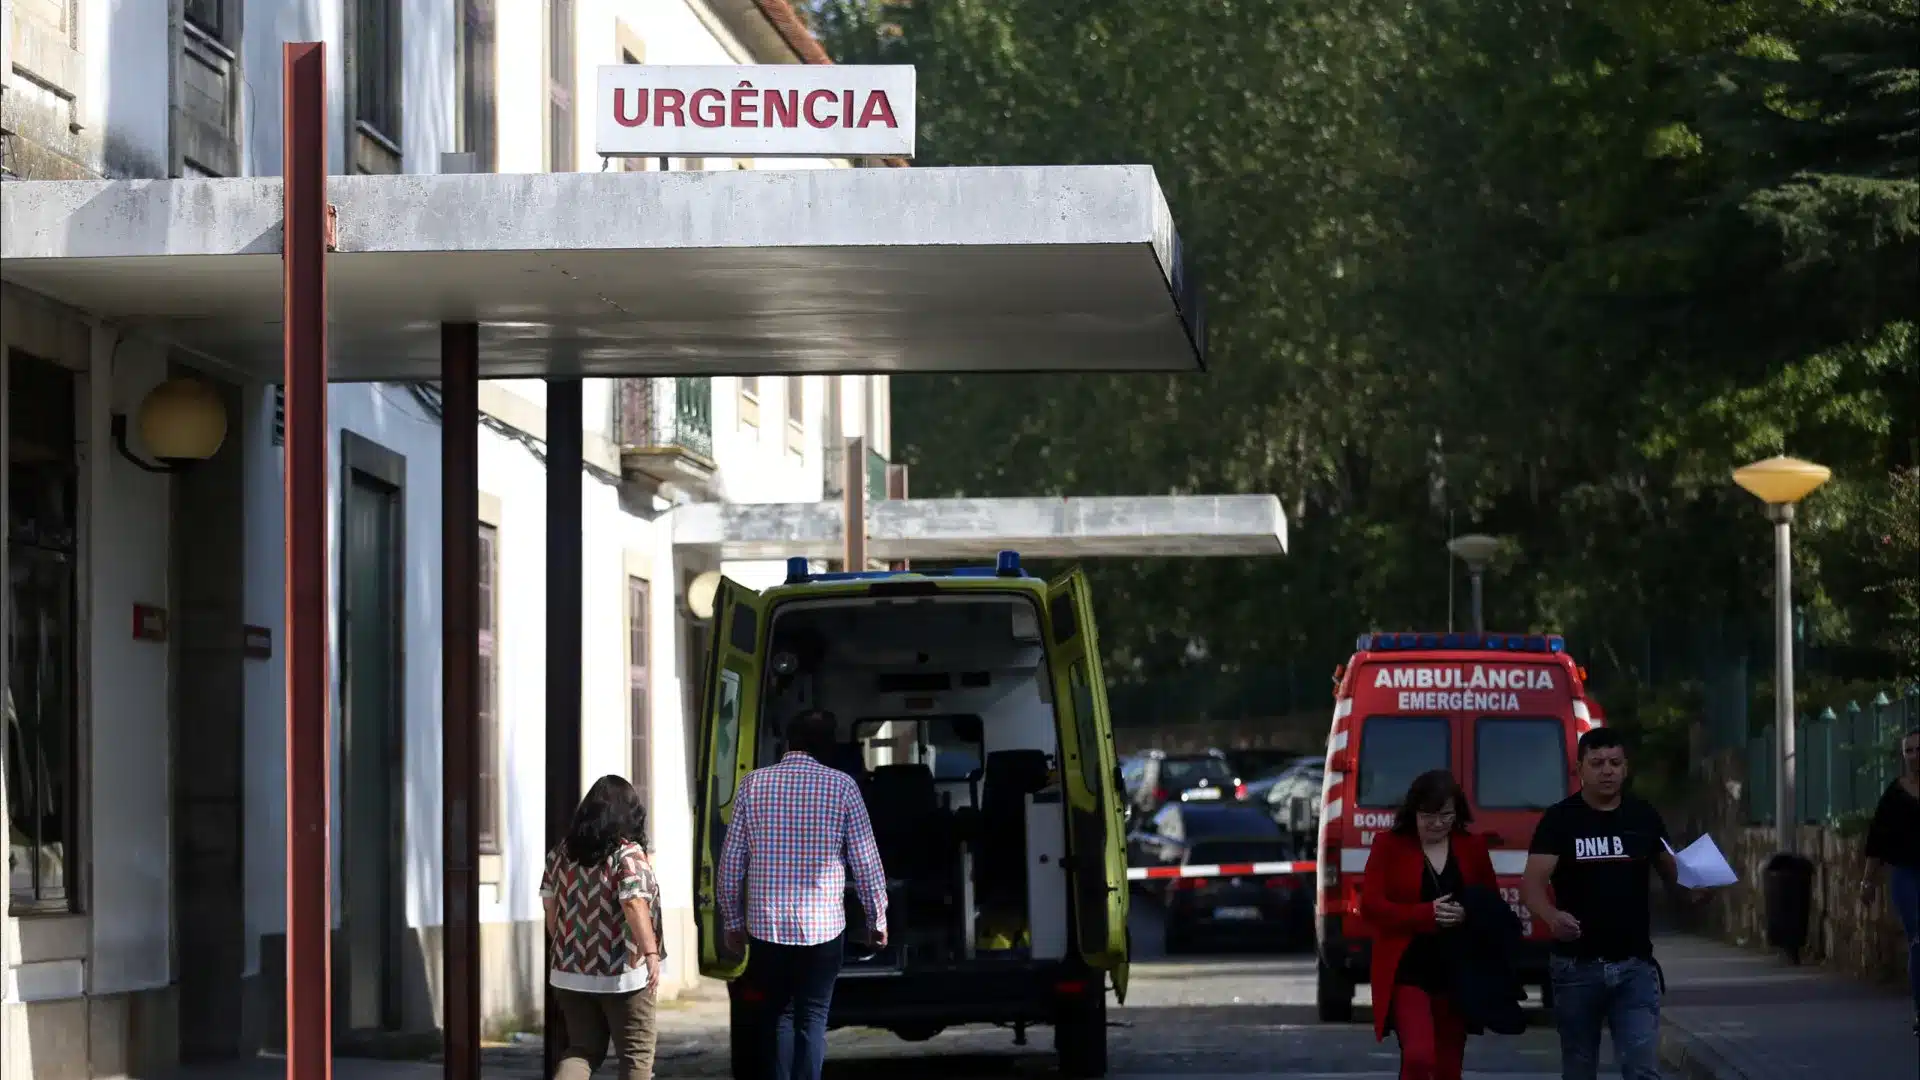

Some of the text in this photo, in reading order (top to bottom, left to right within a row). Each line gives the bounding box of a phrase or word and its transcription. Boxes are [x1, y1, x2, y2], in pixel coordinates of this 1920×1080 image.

[613, 80, 899, 129] URGÊNCIA
[1374, 665, 1554, 689] AMBULÂNCIA
[1398, 690, 1520, 711] EMERGÊNCIA
[1575, 835, 1625, 857] DNM B
